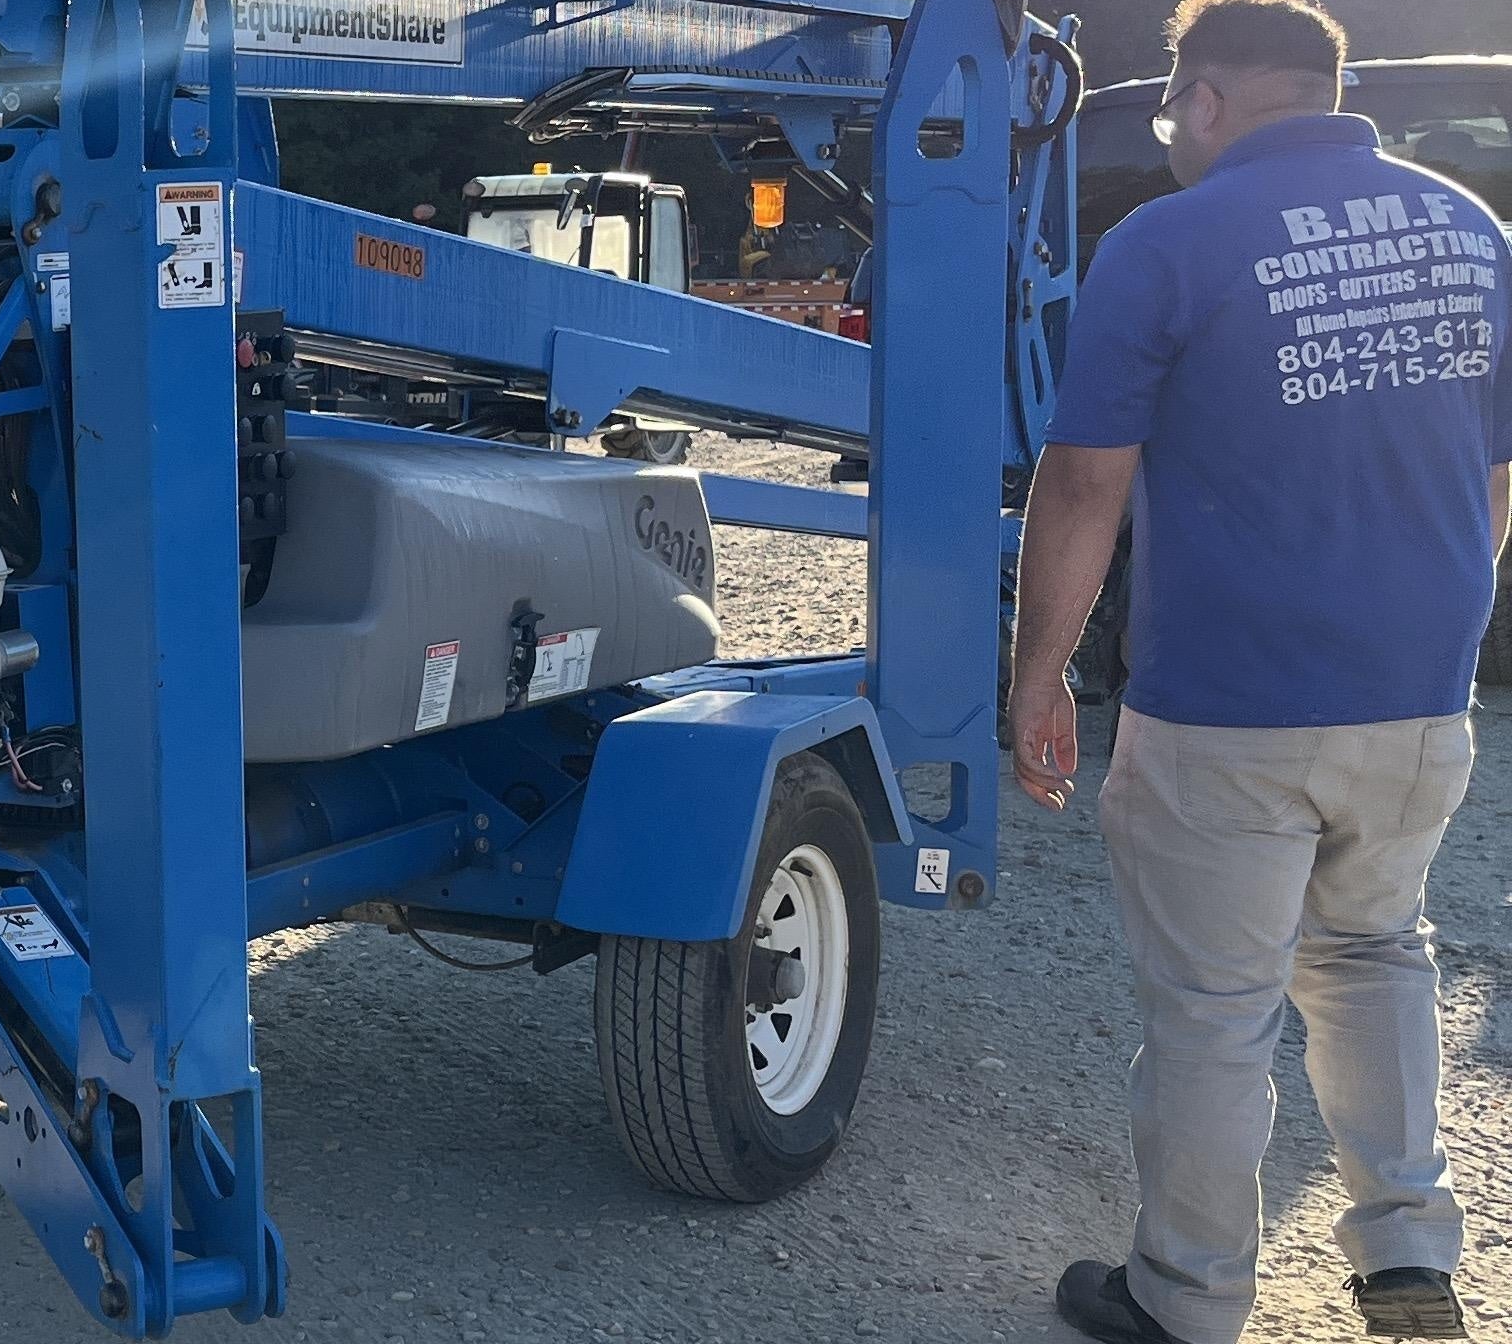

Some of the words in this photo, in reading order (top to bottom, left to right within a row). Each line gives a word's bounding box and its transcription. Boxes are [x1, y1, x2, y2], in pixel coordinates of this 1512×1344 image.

[171, 189, 214, 200] WARNING
[1281, 192, 1454, 246] B.M.F
[358, 237, 423, 277] 109098
[1253, 229, 1497, 286] CONTRACTING
[1268, 282, 1327, 315] ROOFS
[1339, 268, 1417, 301] GUTTERS
[1430, 262, 1495, 290] PAINTING
[1296, 315, 1313, 338] All
[1312, 312, 1347, 334] Home
[1346, 305, 1390, 329] Repairs
[1389, 298, 1436, 322] Interior
[634, 494, 707, 589] Genie
[435, 644, 456, 657] DANGER
